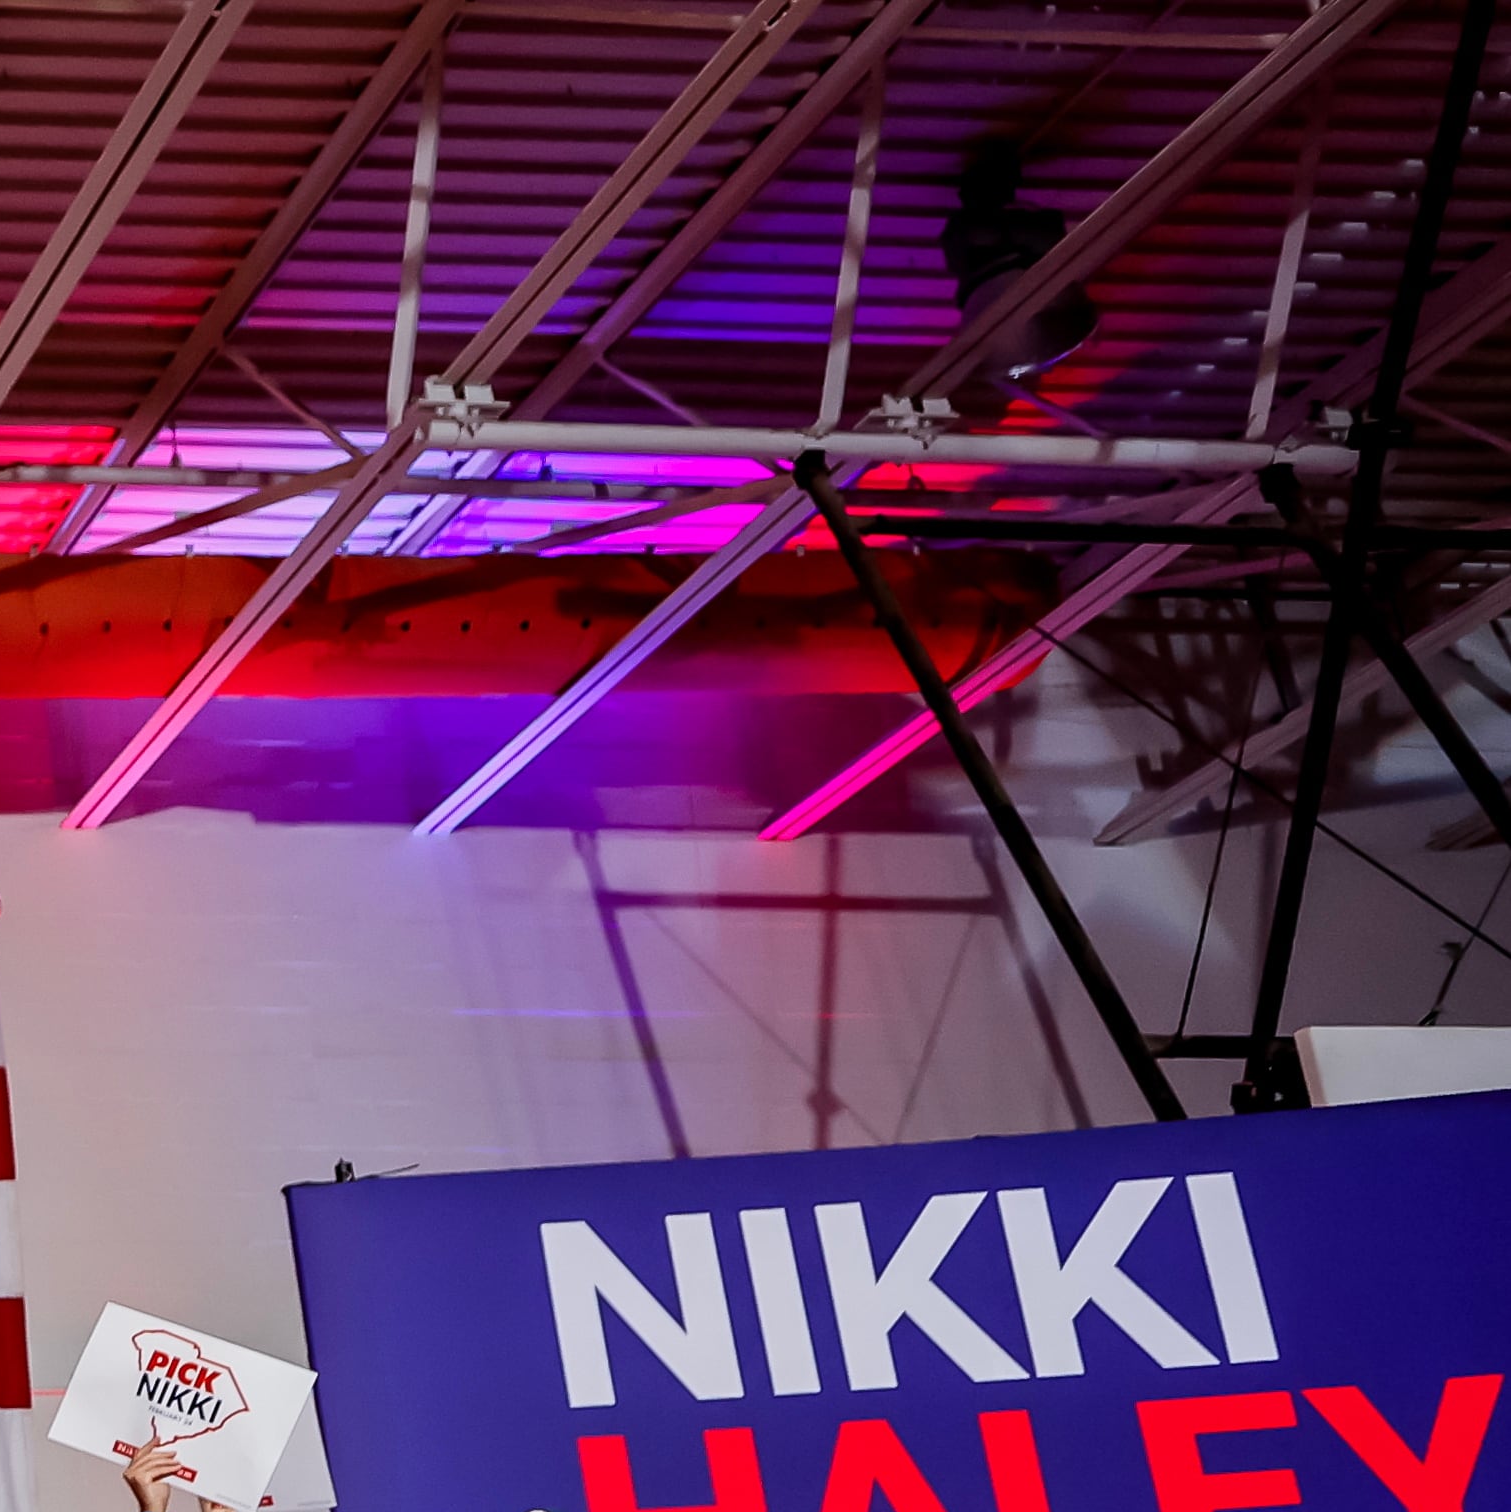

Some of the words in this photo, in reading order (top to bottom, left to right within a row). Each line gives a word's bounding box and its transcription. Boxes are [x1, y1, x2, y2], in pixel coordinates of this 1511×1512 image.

[540, 1171, 1280, 1410] NIKKI
[146, 1350, 221, 1394] PICK
[136, 1373, 222, 1423] NIKKI
